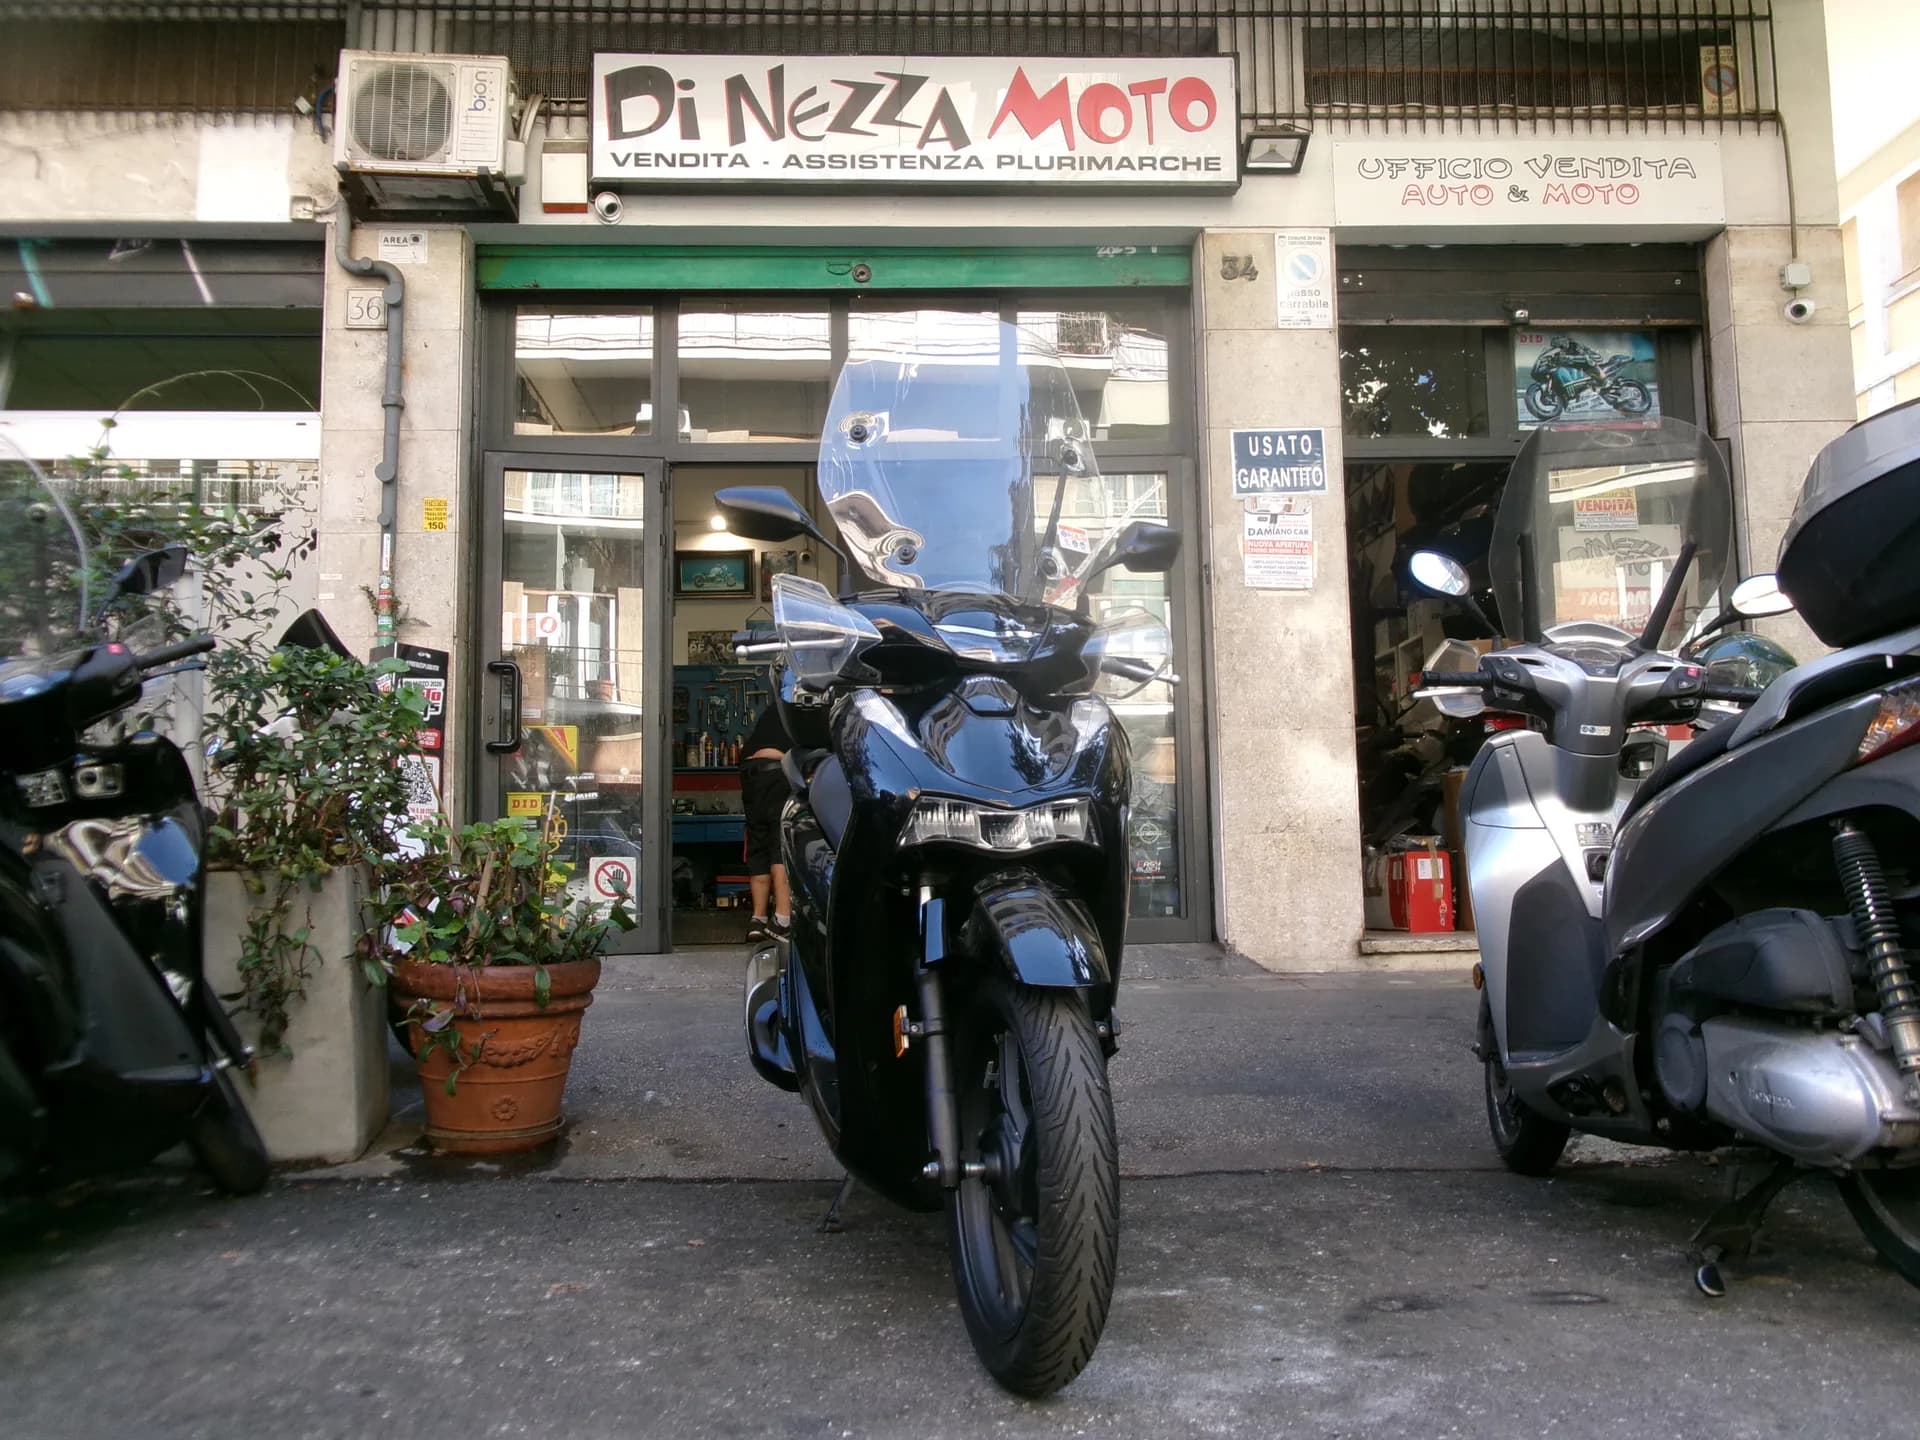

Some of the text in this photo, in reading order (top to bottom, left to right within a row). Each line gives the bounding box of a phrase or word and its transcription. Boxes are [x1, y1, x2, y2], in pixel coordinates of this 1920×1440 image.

[468, 71, 487, 111] bion
[987, 65, 1218, 151] MOTO
[610, 152, 749, 169] VENDITA
[782, 152, 985, 171] ASSISTENZA
[996, 154, 1222, 172] PLURIMARCHE
[1357, 153, 1698, 180] UFFICIO VENDITA
[1401, 183, 1641, 207] AUTO & MOTO
[383, 236, 409, 244] AREA
[350, 295, 384, 321] 36
[1279, 299, 1330, 309] carrabile
[1519, 334, 1544, 344] DID
[1249, 434, 1312, 456] USATO
[1237, 466, 1324, 489] GARANTITO
[1247, 528, 1293, 537] DAMIANO
[511, 799, 539, 809] DID
